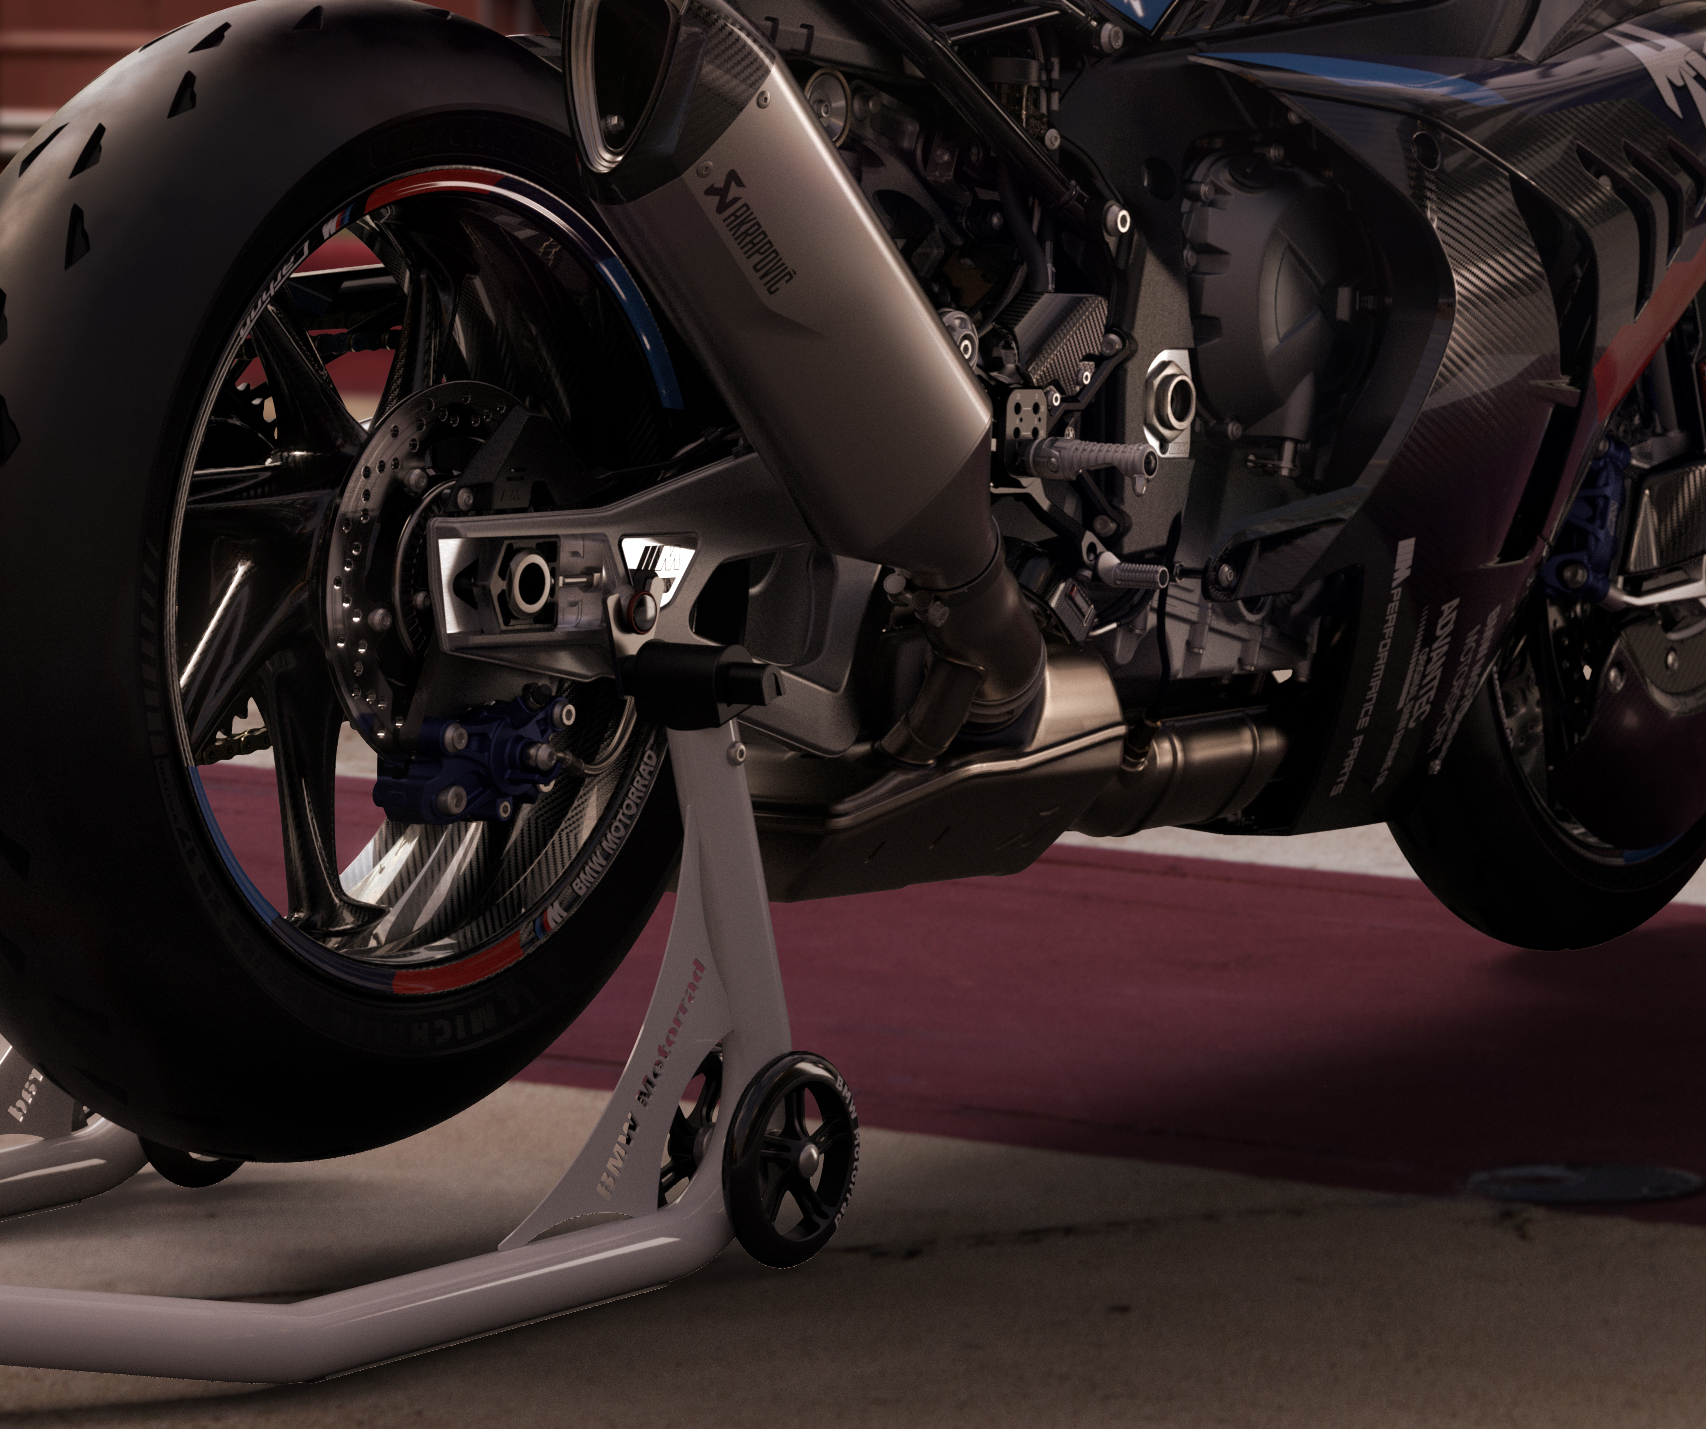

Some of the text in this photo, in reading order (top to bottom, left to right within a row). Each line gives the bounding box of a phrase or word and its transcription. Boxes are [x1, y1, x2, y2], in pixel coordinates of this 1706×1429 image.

[1356, 587, 1402, 732] PERFORMANCE
[1407, 597, 1461, 729] ADVANTEC
[571, 848, 608, 897] BMW
[599, 749, 658, 855] MOTORRAD
[1329, 734, 1365, 797] PARTS
[596, 957, 706, 1201] BMW Motorrad
[835, 1074, 858, 1120] BMW
